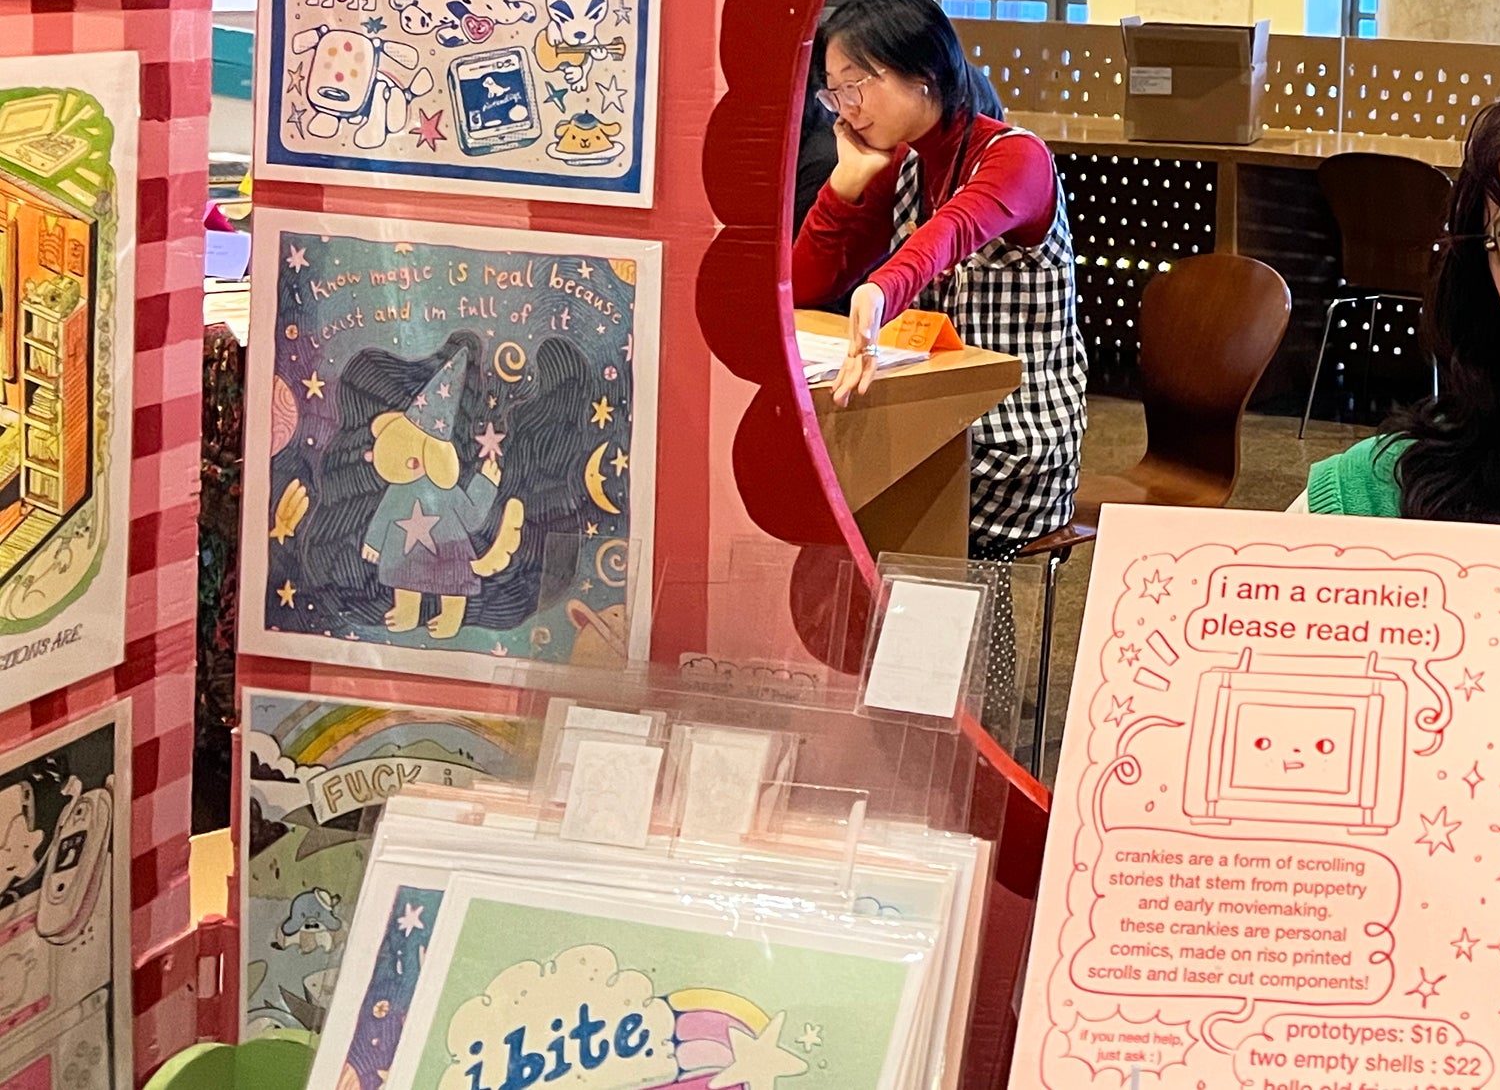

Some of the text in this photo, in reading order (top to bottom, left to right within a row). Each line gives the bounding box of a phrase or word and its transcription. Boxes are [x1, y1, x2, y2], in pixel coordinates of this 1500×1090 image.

[293, 284, 302, 304] i
[370, 266, 433, 290] magic
[448, 261, 468, 286] is
[484, 260, 534, 289] real
[549, 263, 622, 324] because
[310, 297, 570, 348] i exist and im full of it
[1220, 576, 1428, 608] i am a crankie!
[50, 623, 83, 652] ARE
[1201, 615, 1441, 651] please read me:)
[322, 764, 421, 813] FUCK
[1115, 848, 1365, 876] crankies are a form of scrolling
[1109, 872, 1367, 899] stories that stem from puppetry
[1138, 895, 1332, 921] and early moviemaking.
[1120, 918, 1347, 946] these crankies are personal
[1110, 943, 1352, 969] comics, made on riso printed
[1088, 964, 1370, 992] scrolls and laser cut components!
[498, 1003, 653, 1090] bite.
[1080, 1032, 1090, 1044] if
[1093, 1033, 1116, 1048] you
[1119, 1033, 1149, 1045] need
[1286, 1021, 1449, 1046] prototypes: $16
[1096, 1049, 1119, 1064] just
[1124, 1050, 1145, 1062] ask
[1249, 1049, 1287, 1068] two
[1294, 1053, 1358, 1075] empty
[1365, 1053, 1424, 1073] shells
[1443, 1055, 1481, 1076] $22
